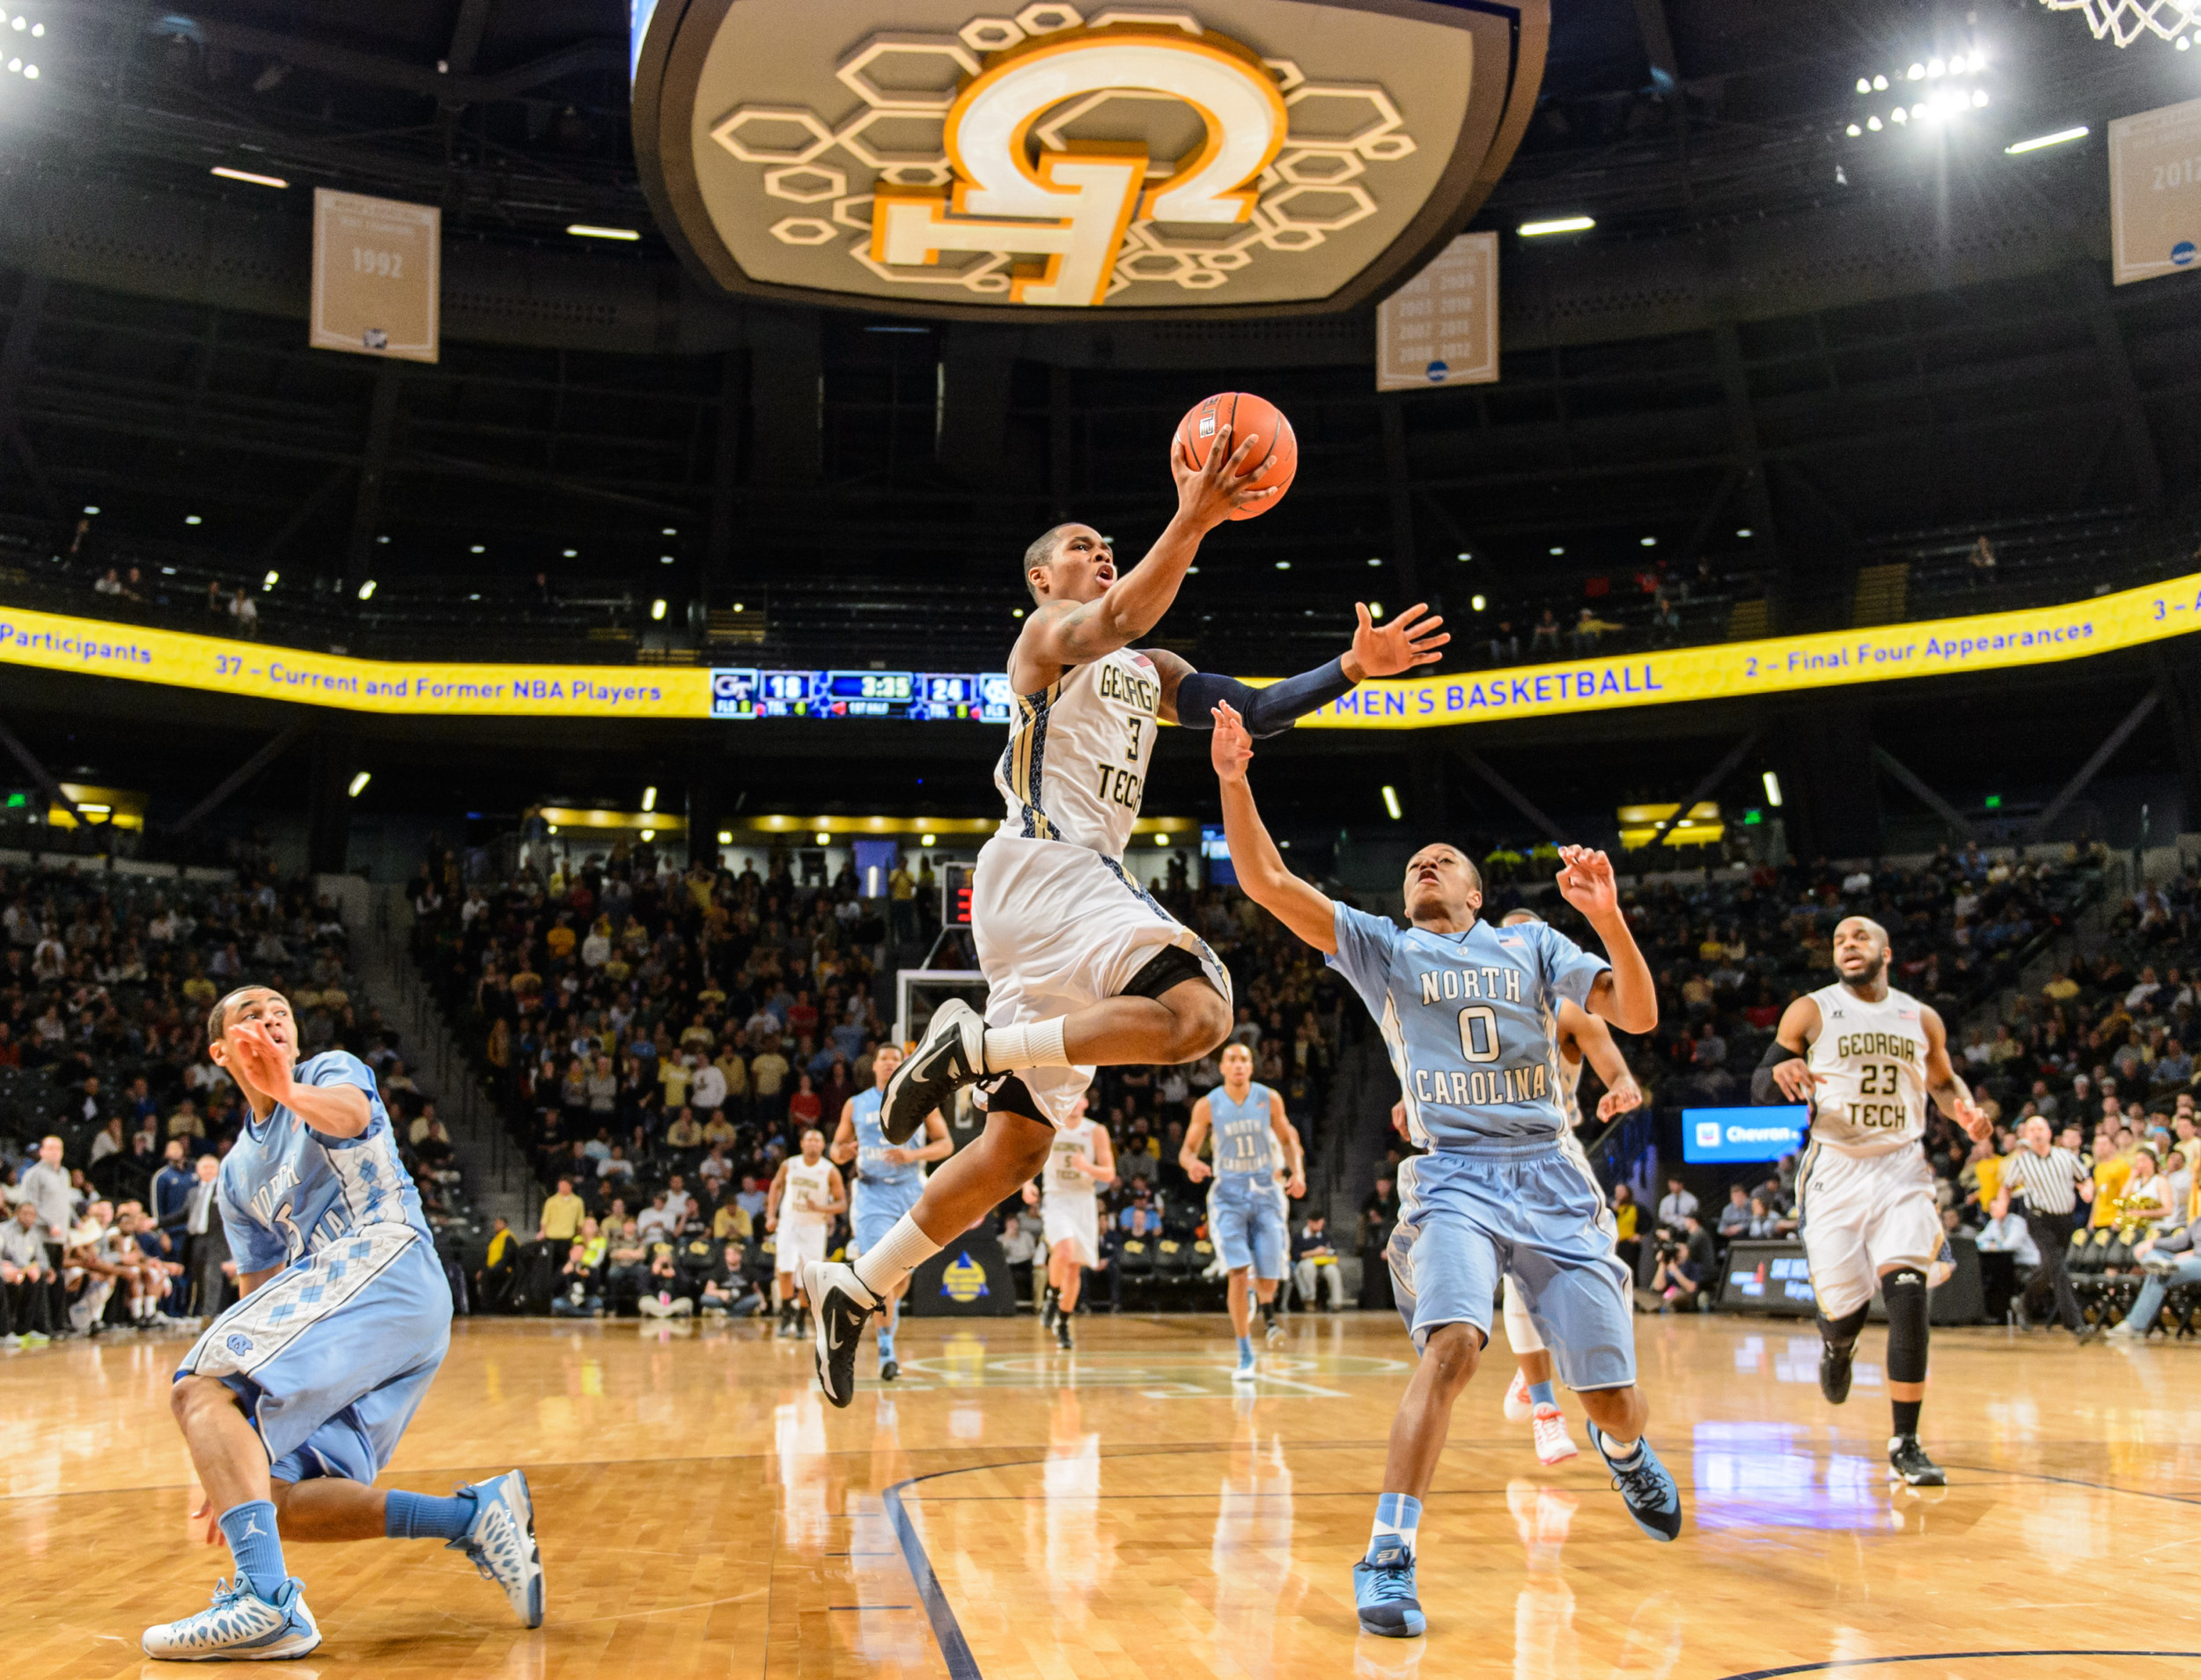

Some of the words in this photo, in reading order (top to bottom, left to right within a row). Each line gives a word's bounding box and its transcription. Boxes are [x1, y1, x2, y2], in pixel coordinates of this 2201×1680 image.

[353, 247, 403, 279] 1992
[2153, 599, 2166, 621] 3
[0, 623, 151, 664] Participants
[1746, 657, 1757, 677] 2
[1787, 647, 1849, 673] Final
[1858, 643, 1916, 664] Four
[1925, 622, 2094, 659] Appearances
[216, 654, 242, 675] 37
[269, 662, 358, 694] Current
[365, 678, 408, 697] and
[416, 678, 505, 698] Former
[513, 680, 564, 699] NBA
[572, 680, 661, 704] Players
[770, 675, 802, 699] 18
[932, 678, 963, 702] 24
[1335, 689, 1435, 716] MEN'S
[1446, 665, 1663, 711] BASKETBALL
[1126, 716, 1142, 763] 3
[1420, 967, 1521, 1006] NORTH
[1457, 1005, 1502, 1064] 0
[1838, 1032, 1916, 1063] GEORGIA
[1415, 1064, 1546, 1106] CAROLINA
[1860, 1065, 1898, 1094] 23
[1224, 1119, 1262, 1137] NORTH
[1849, 1103, 1907, 1128] TECH
[1235, 1134, 1255, 1158] 11
[1726, 1125, 1790, 1143] Chevron
